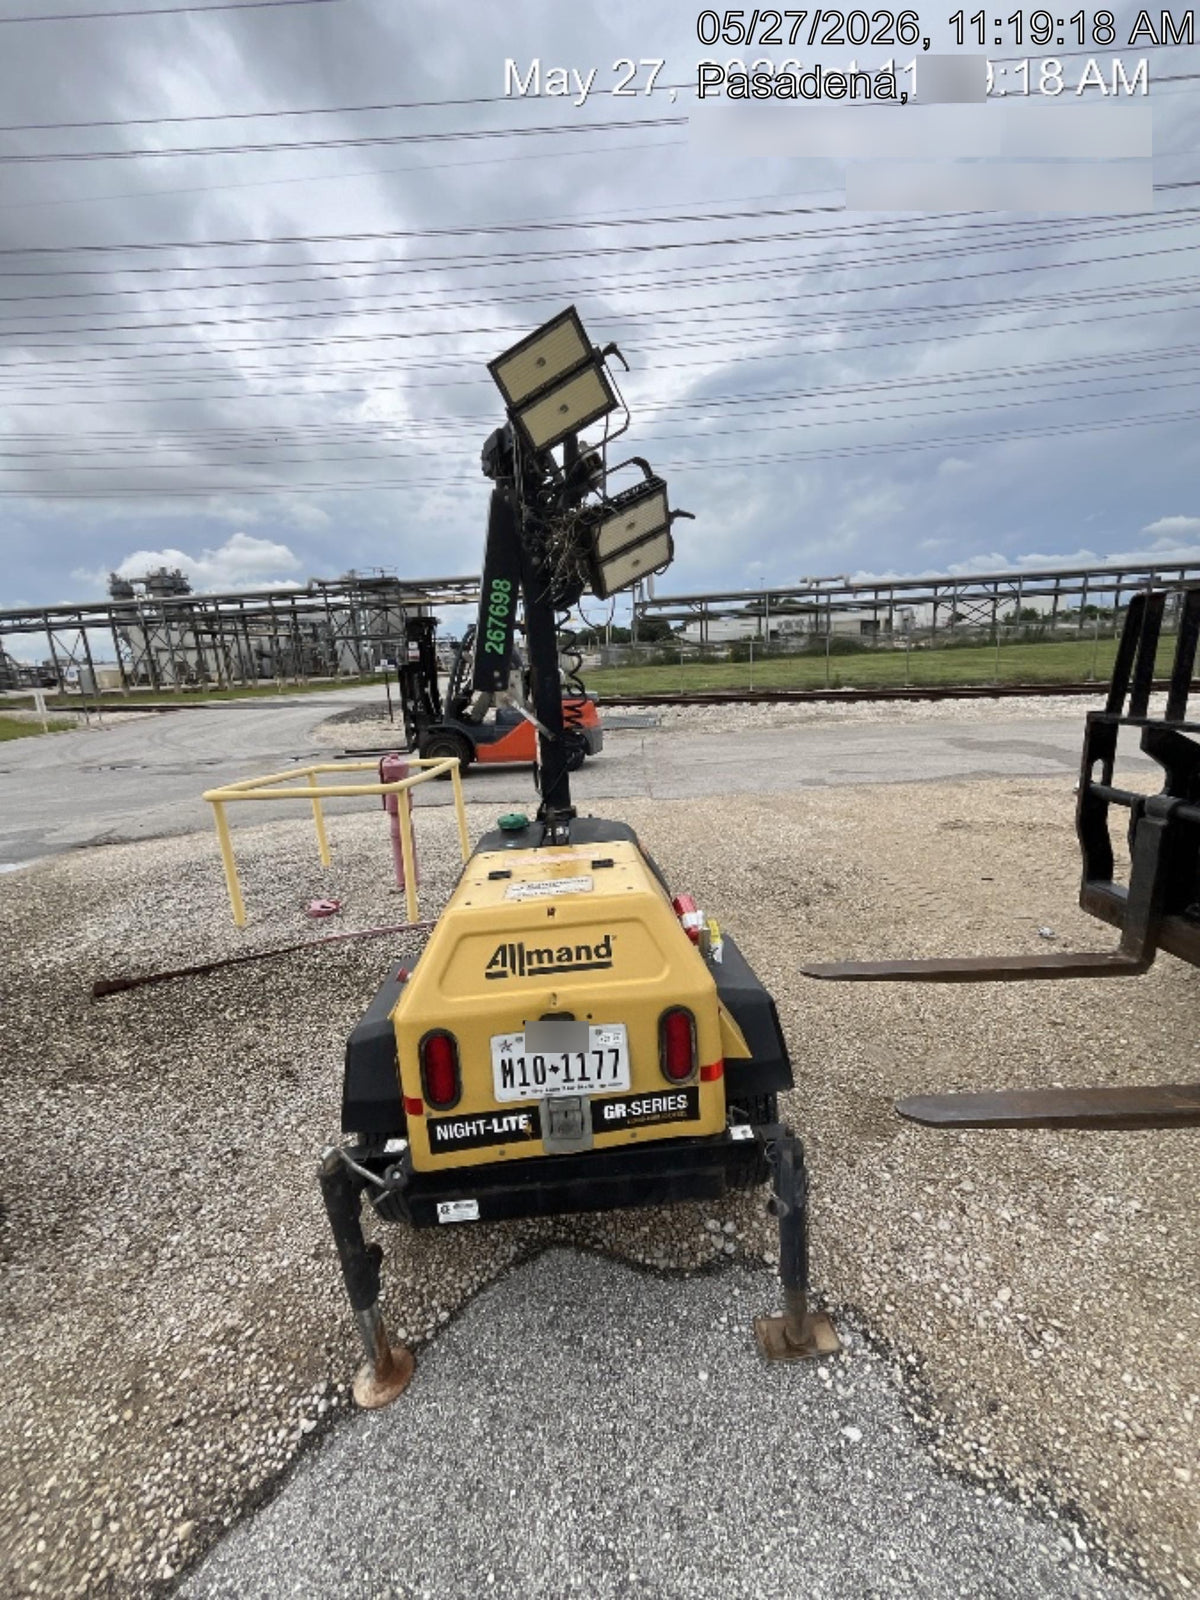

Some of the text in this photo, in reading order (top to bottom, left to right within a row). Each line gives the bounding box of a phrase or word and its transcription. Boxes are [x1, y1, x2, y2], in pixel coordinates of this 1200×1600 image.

[484, 579, 512, 655] 267698
[485, 934, 613, 978] Allmand
[603, 1094, 688, 1119] GR-SERIES
[436, 1113, 530, 1140] NIGHT-LITE
